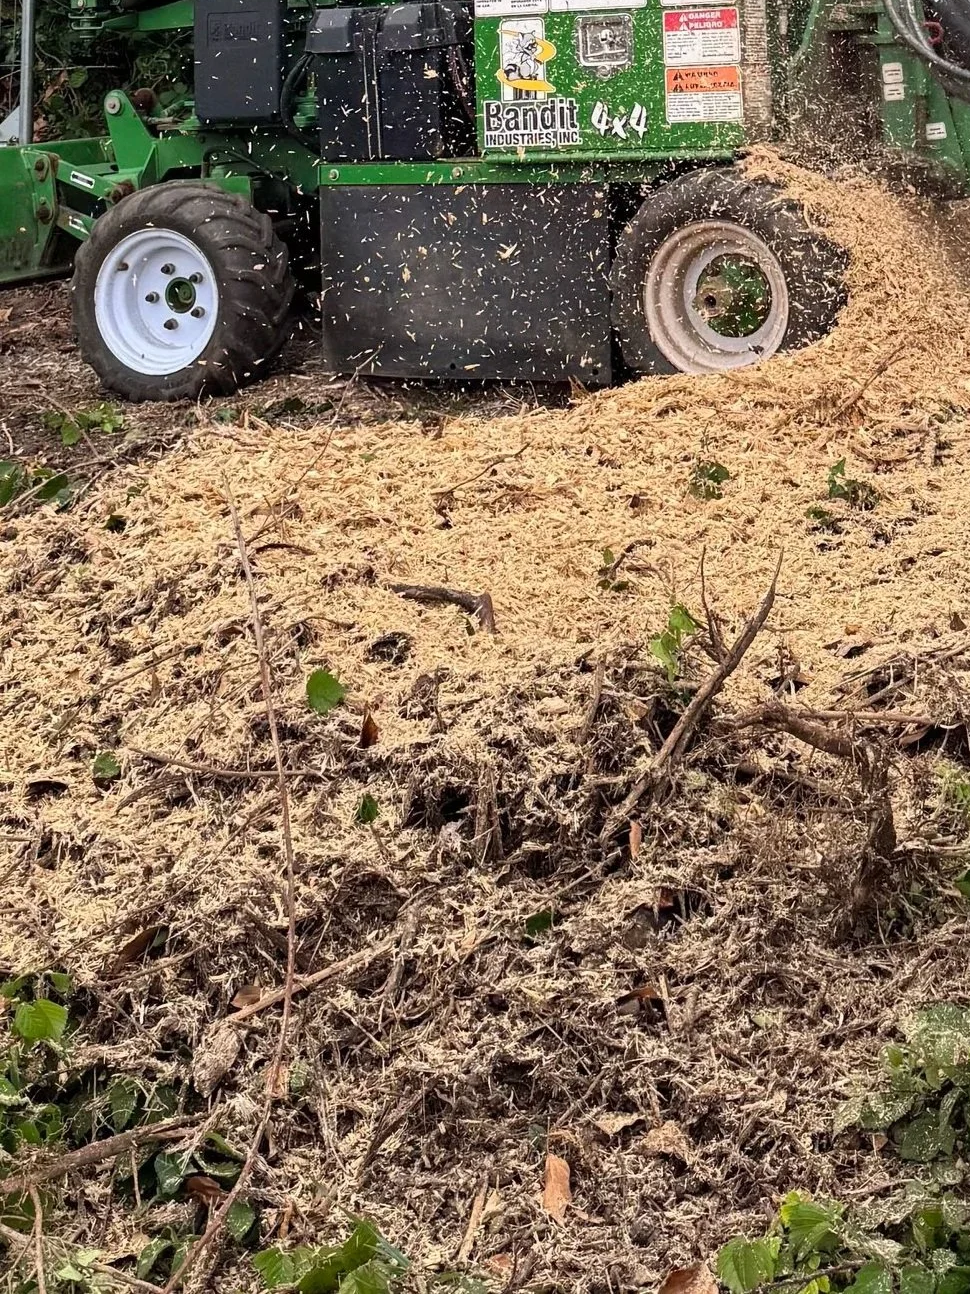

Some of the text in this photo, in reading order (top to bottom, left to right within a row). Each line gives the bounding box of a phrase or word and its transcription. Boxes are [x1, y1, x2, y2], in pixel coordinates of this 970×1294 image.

[688, 11, 722, 20] DANGER
[688, 21, 724, 29] PELIGRO
[485, 99, 578, 132] Bandit
[591, 101, 648, 140] 4x4
[485, 131, 583, 147] INDUSTRIES, INC.
